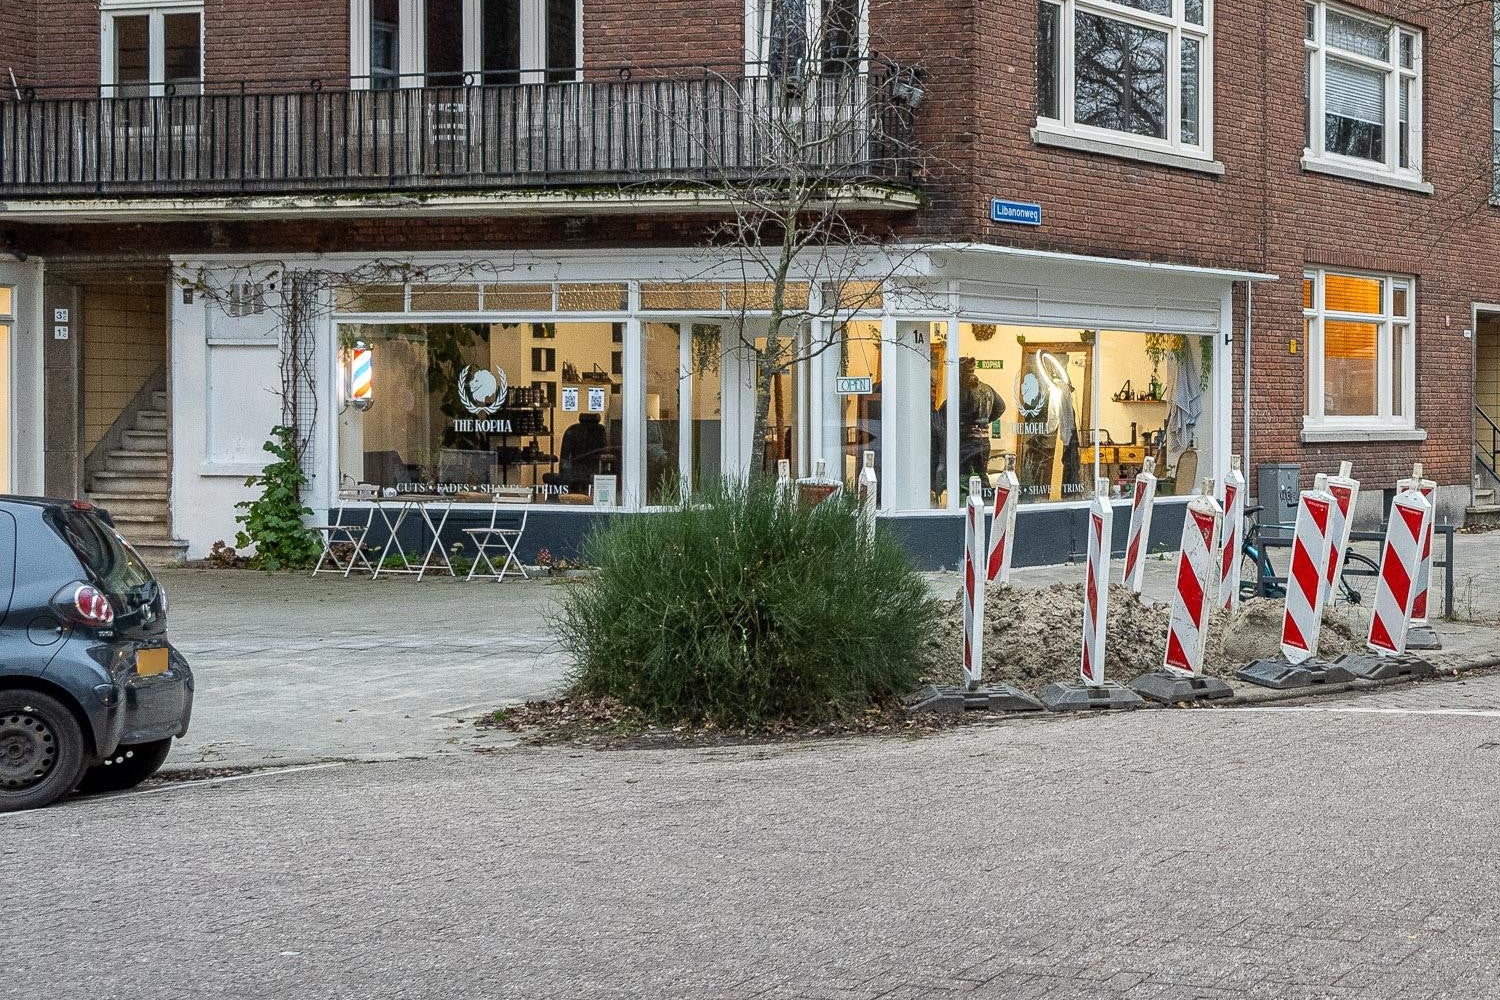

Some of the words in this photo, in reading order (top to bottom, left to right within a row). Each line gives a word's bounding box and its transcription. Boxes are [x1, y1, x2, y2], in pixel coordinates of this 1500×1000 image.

[997, 204, 1038, 221] Libanonweg
[913, 330, 924, 344] 1A
[982, 360, 1001, 368] ROPHA
[841, 379, 866, 391] OPEN
[453, 419, 473, 433] THE
[474, 419, 513, 433] ROPHA
[396, 482, 426, 493] CUTS
[437, 483, 470, 493] FADES
[533, 484, 569, 495] TRIMS
[1063, 483, 1085, 493] TRIMS
